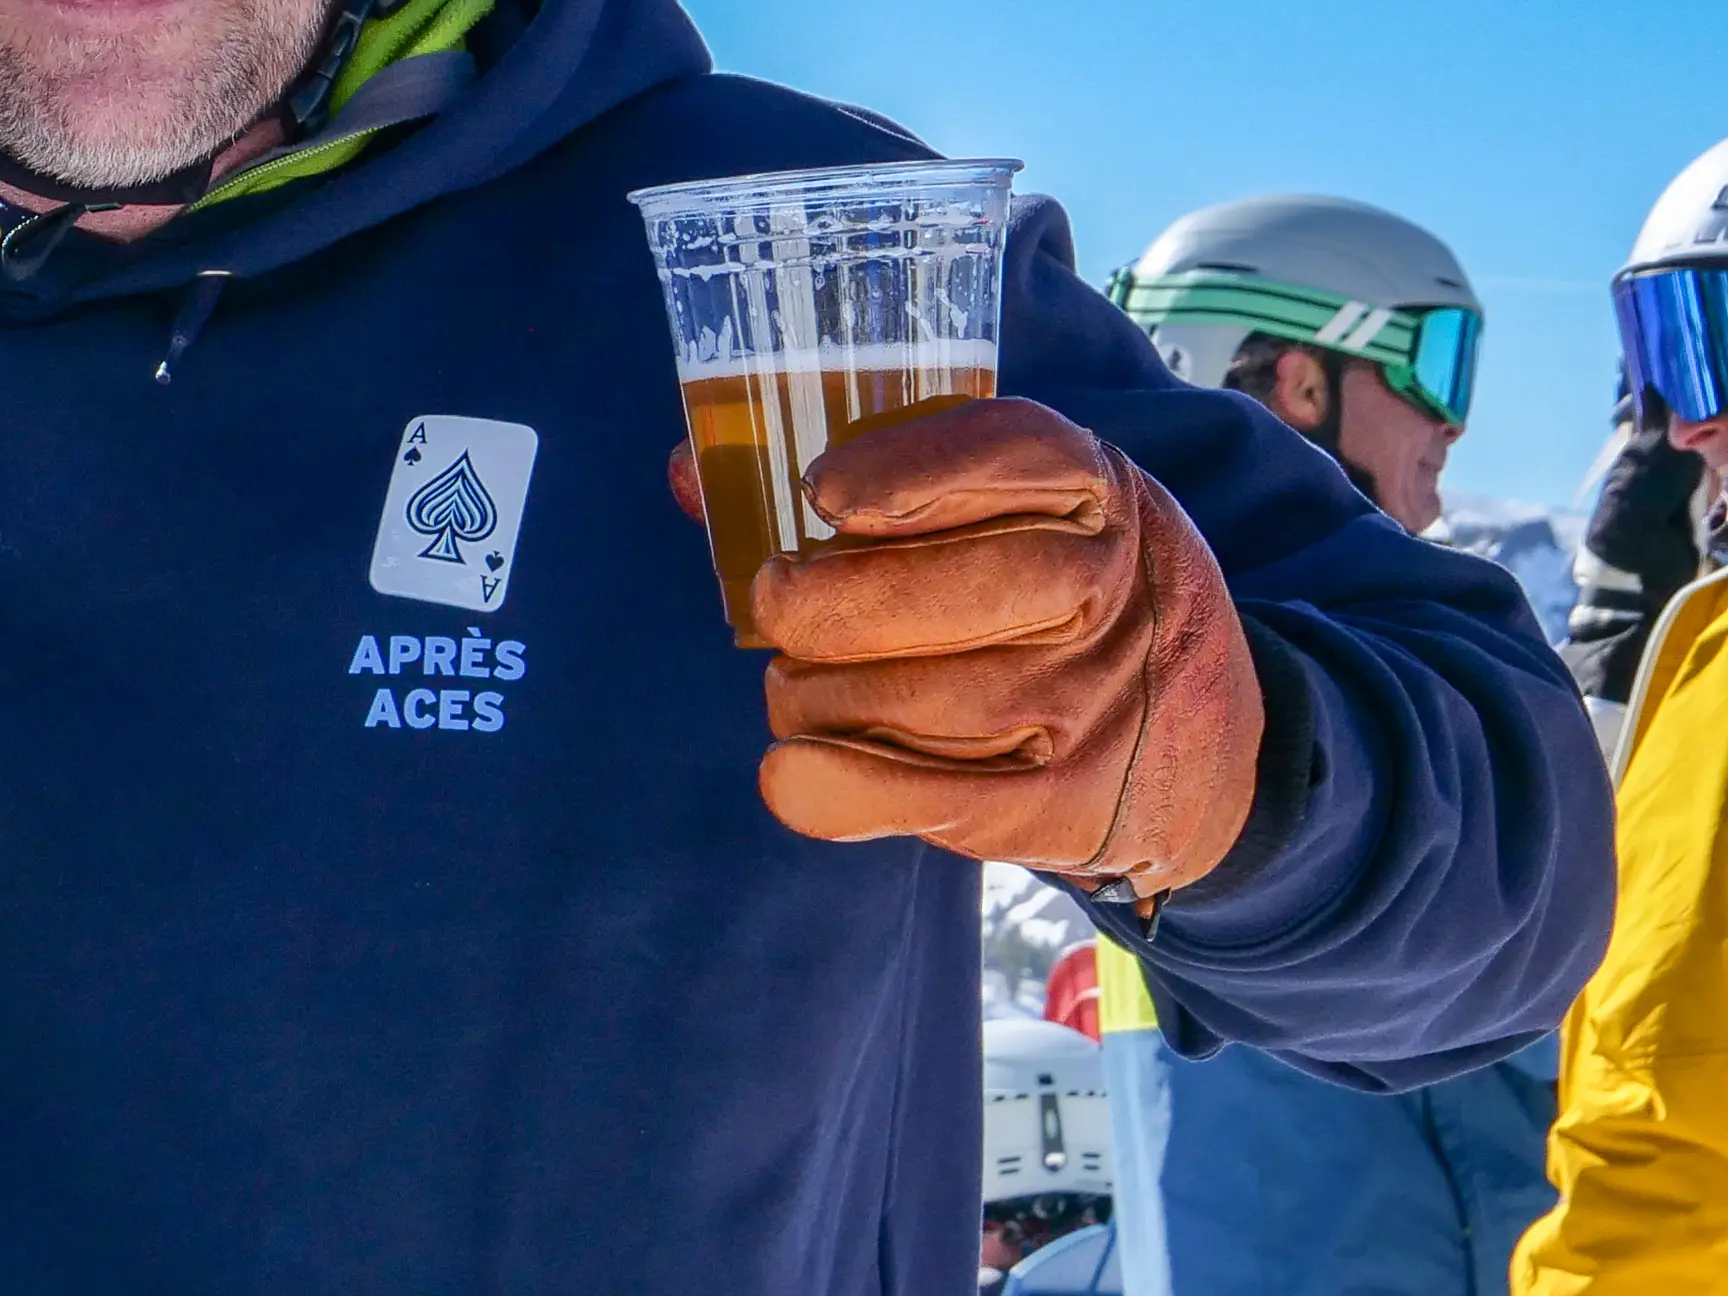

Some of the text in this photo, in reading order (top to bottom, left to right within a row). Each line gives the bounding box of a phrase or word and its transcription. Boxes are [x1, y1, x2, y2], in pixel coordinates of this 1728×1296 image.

[407, 422, 429, 444] A
[349, 626, 527, 681] APRÈS
[364, 687, 506, 733] ACES
